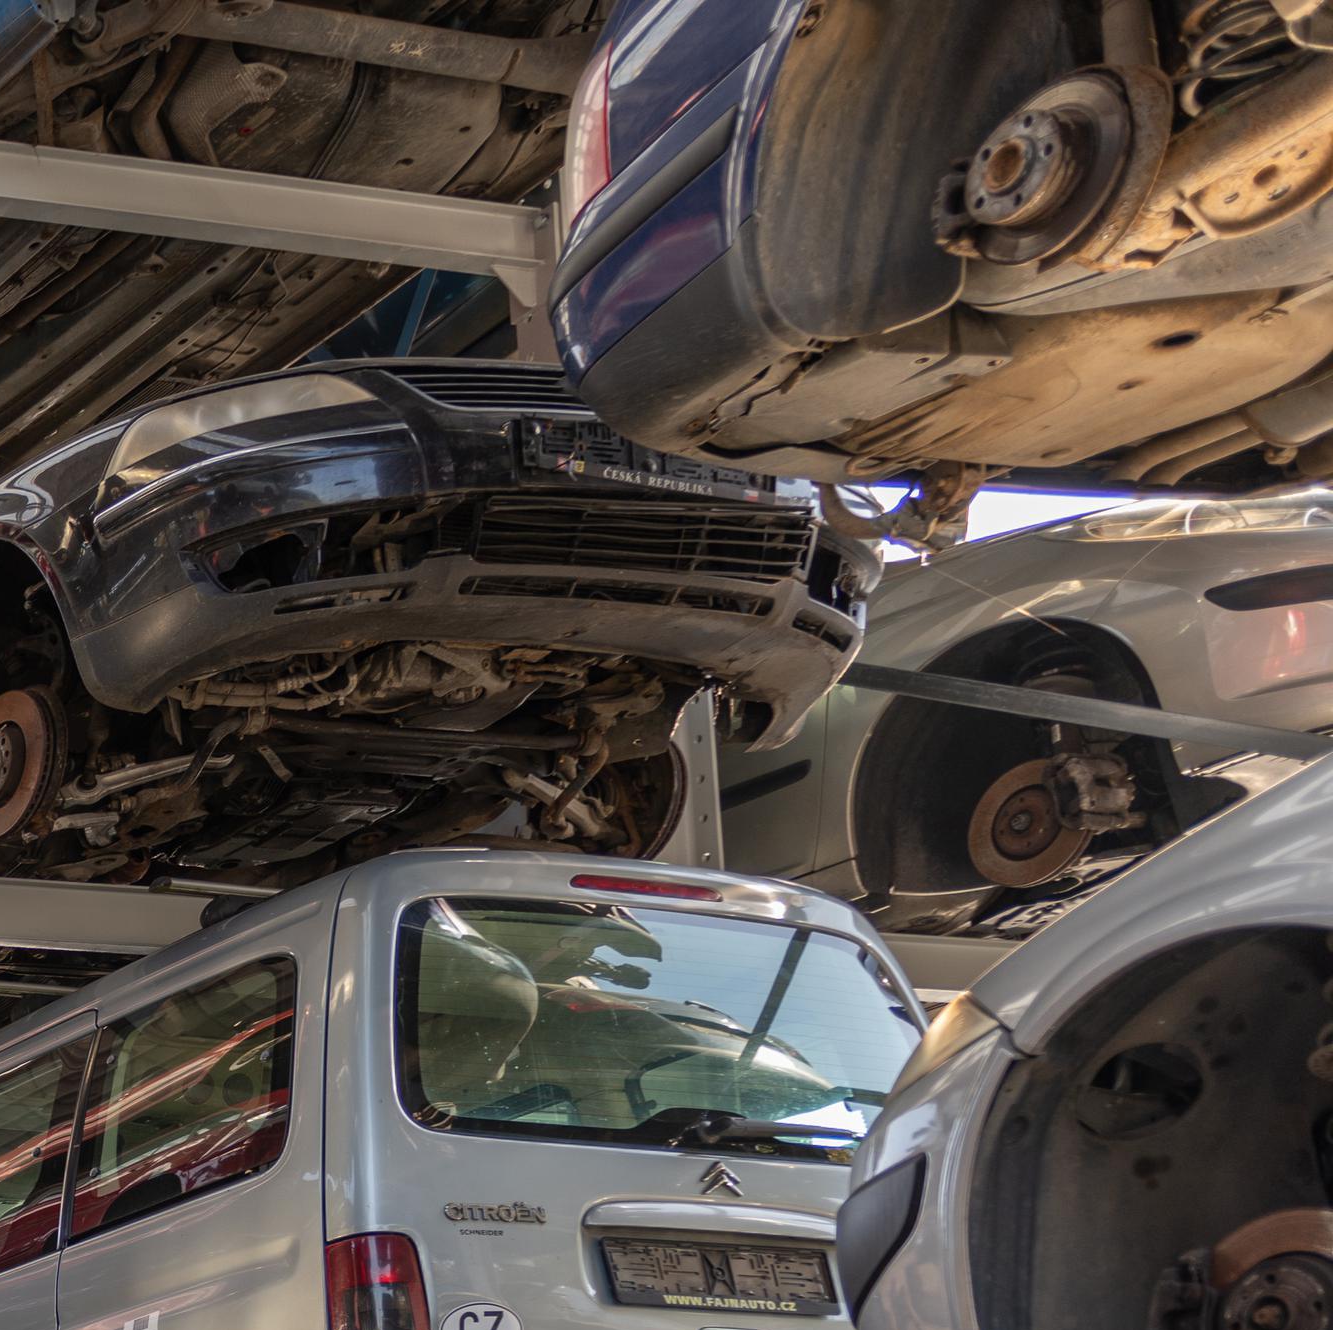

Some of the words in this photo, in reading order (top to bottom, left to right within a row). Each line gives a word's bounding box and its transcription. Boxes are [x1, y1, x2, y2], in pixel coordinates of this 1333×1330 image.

[602, 466, 642, 483] ČESKÁ
[647, 476, 714, 496] REPUBLIKA
[443, 1201, 547, 1223] CITROËN
[662, 1294, 798, 1312] WWW.FAJNAUTO.CZ
